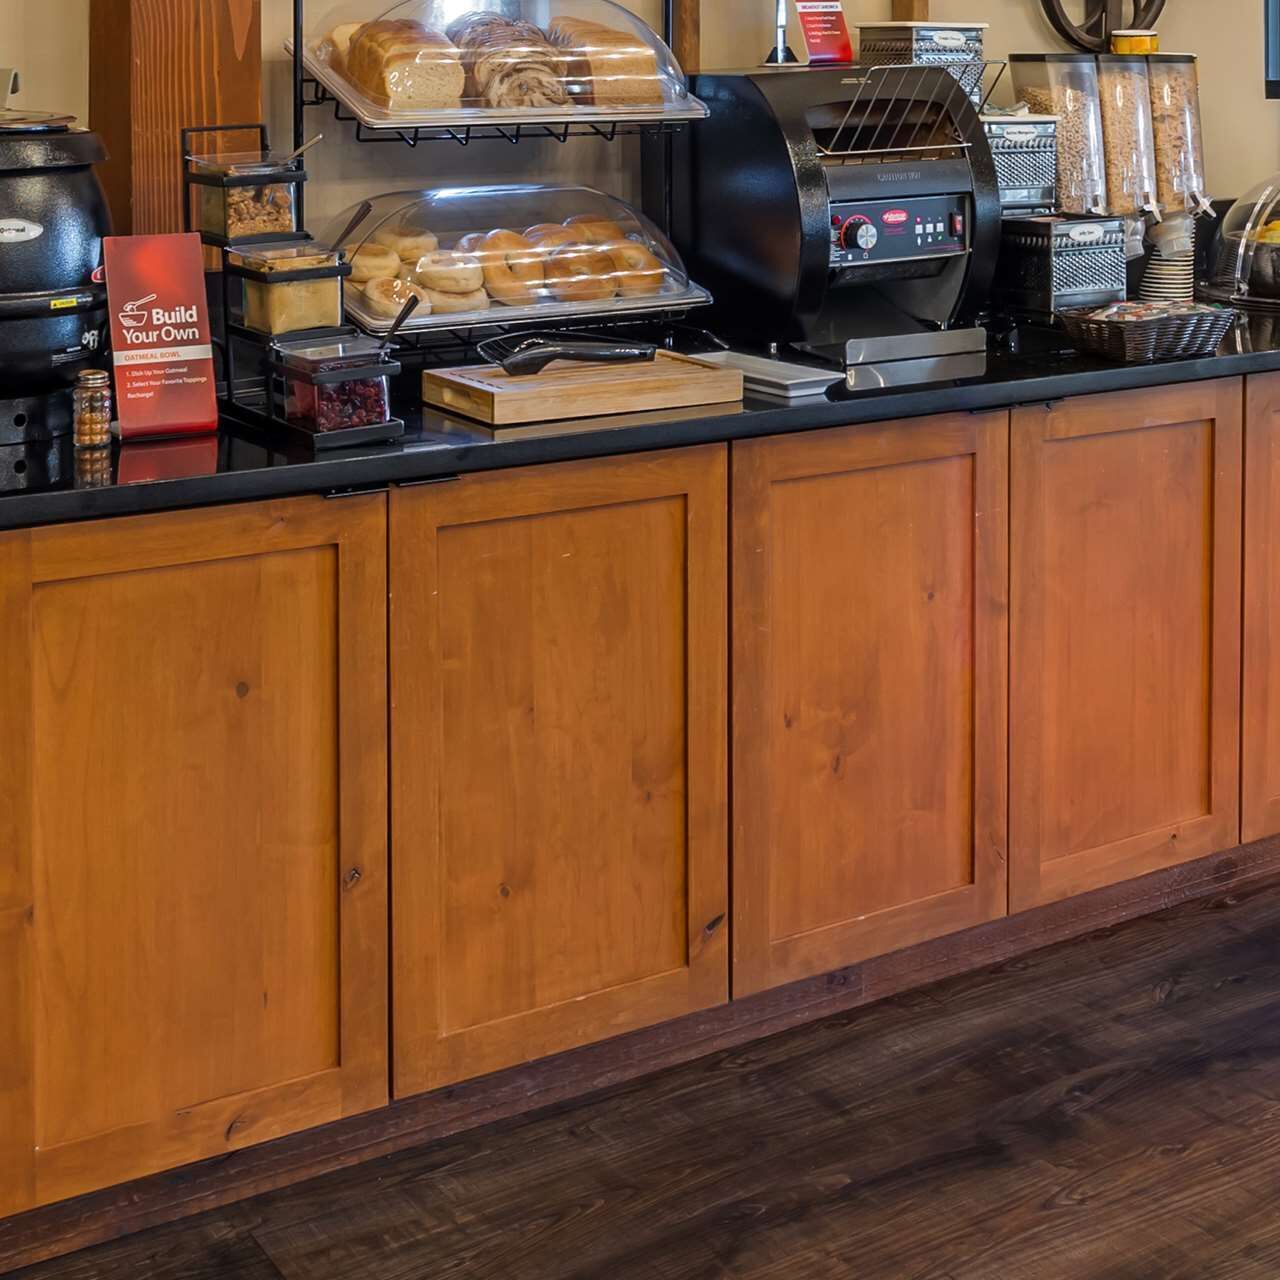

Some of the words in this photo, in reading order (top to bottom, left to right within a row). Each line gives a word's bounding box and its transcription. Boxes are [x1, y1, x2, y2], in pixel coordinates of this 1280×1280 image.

[152, 305, 198, 325] Build
[122, 328, 159, 344] Your
[161, 326, 199, 341] Own
[125, 352, 159, 362] OATMEAL
[160, 351, 181, 360] BOWL
